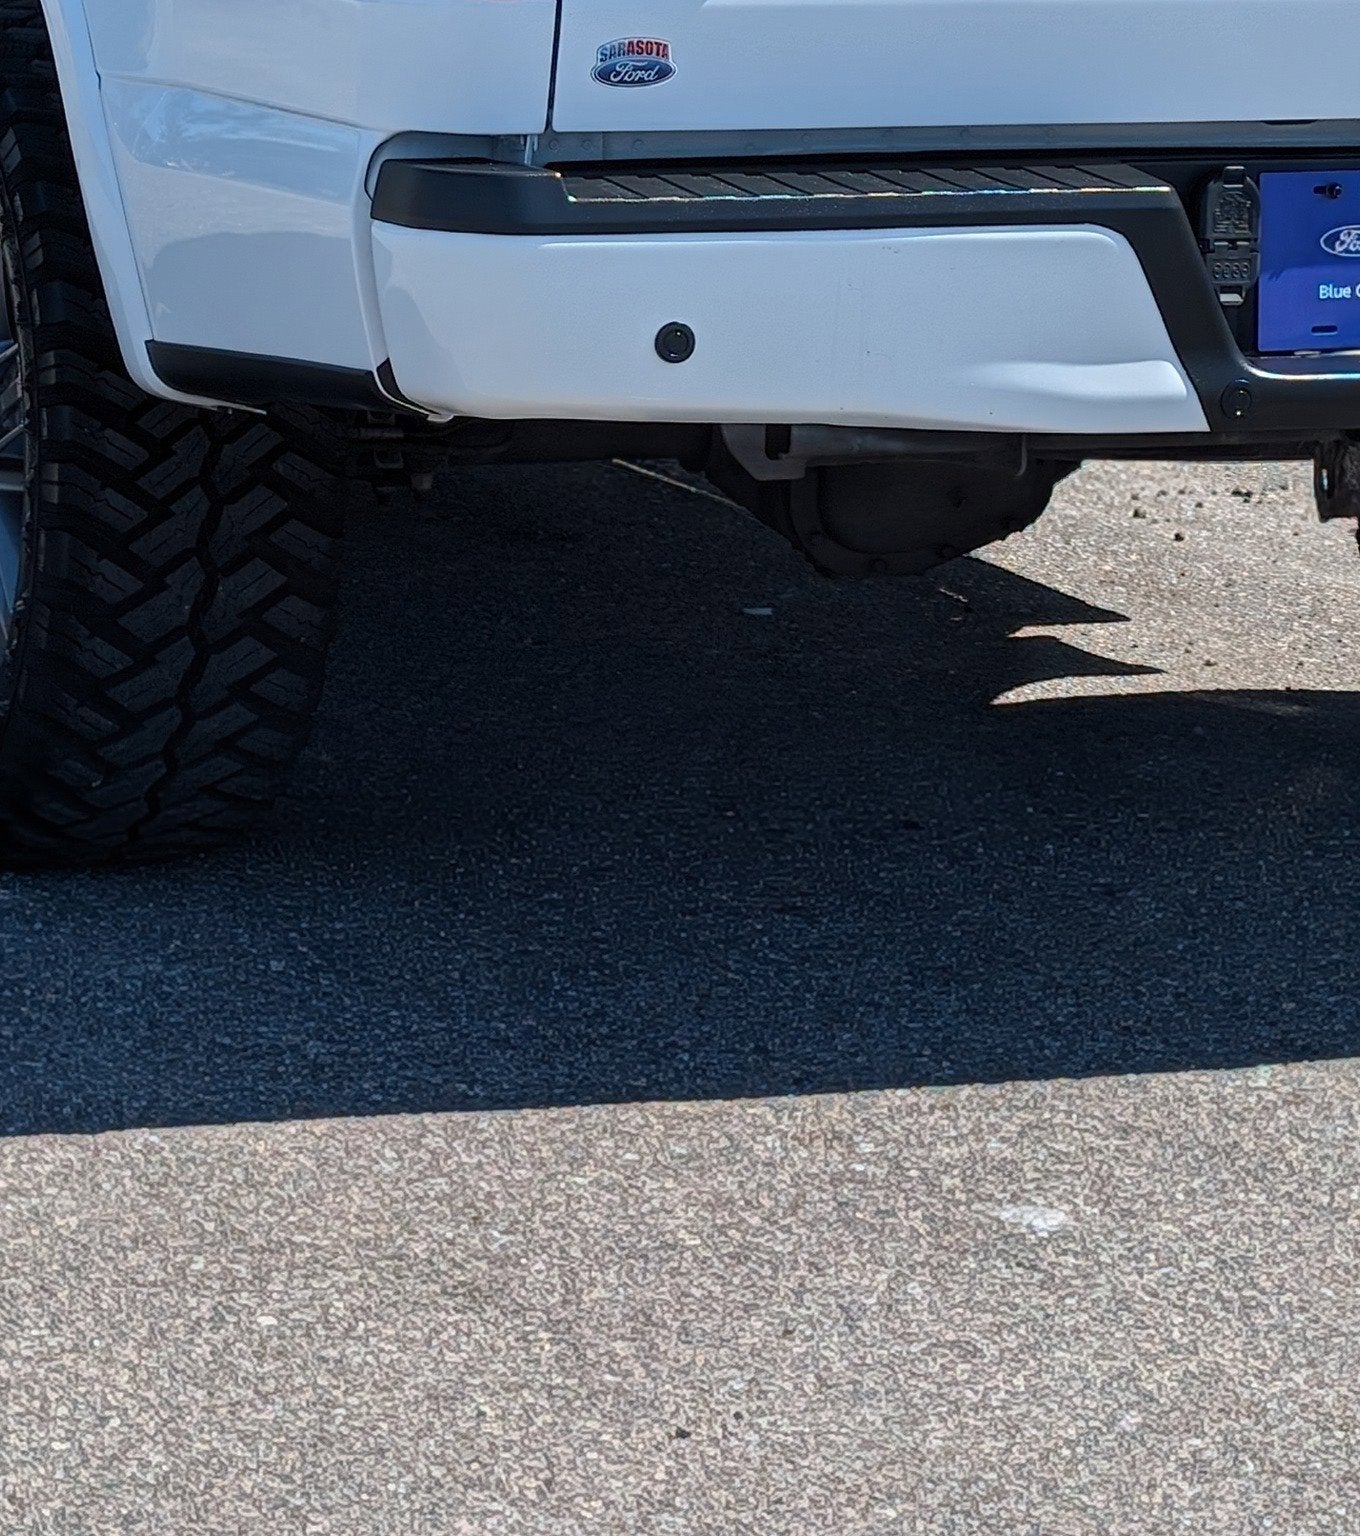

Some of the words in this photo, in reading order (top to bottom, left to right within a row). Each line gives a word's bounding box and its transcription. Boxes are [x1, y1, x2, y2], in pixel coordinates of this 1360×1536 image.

[599, 39, 670, 63] SARASOTA
[610, 61, 660, 82] Ford
[1318, 284, 1351, 300] Blue
